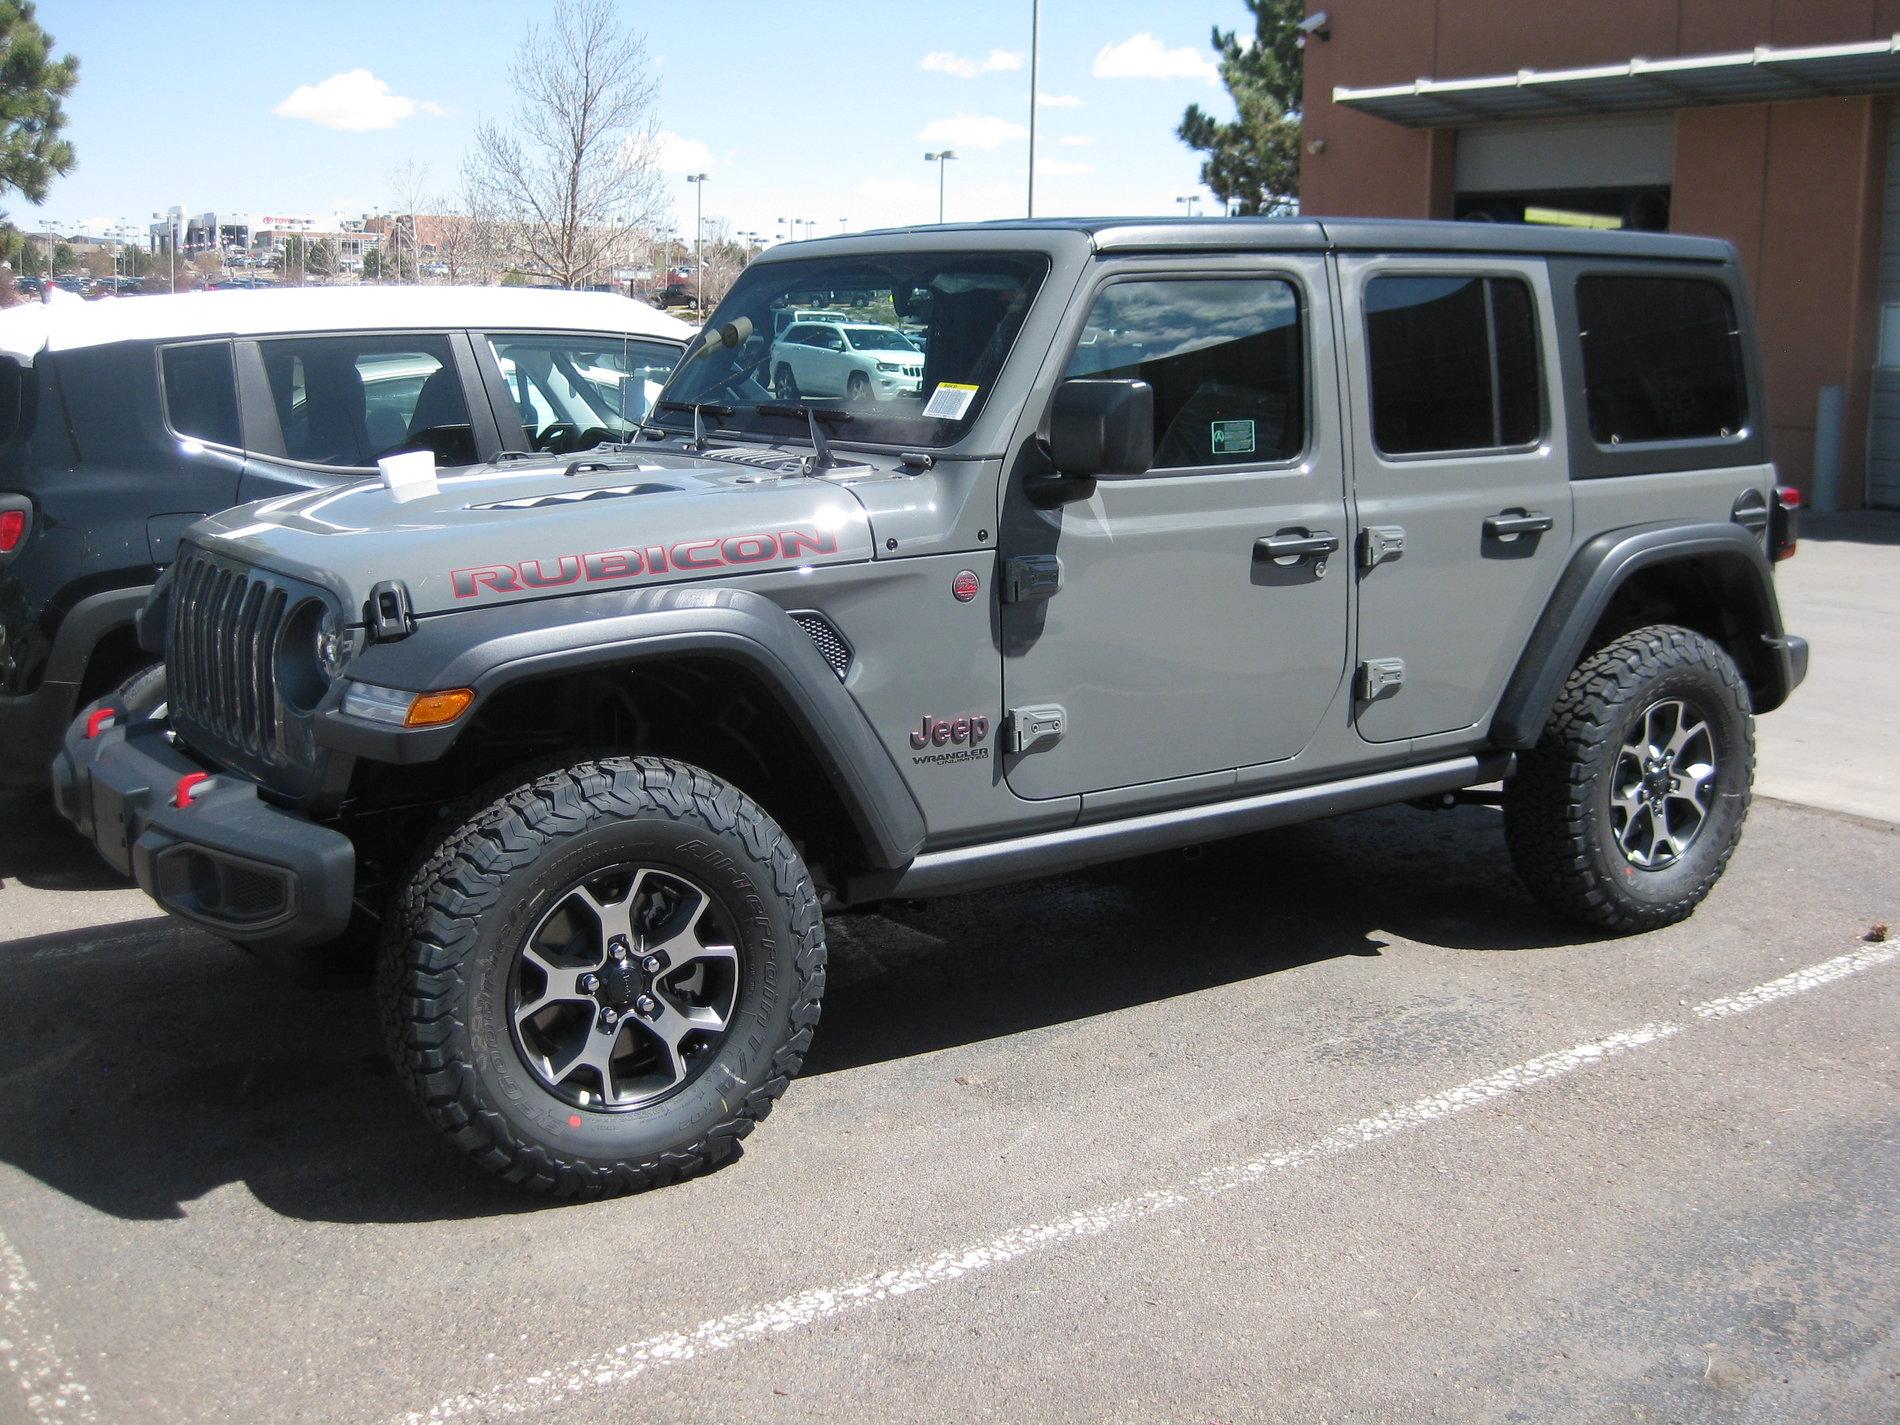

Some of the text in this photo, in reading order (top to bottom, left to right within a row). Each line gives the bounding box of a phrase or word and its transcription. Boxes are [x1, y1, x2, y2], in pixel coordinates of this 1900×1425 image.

[450, 528, 838, 599] RUBICON
[909, 715, 989, 750] Jeep
[912, 748, 989, 765] WRANGLER
[937, 754, 989, 766] UNLIMITED
